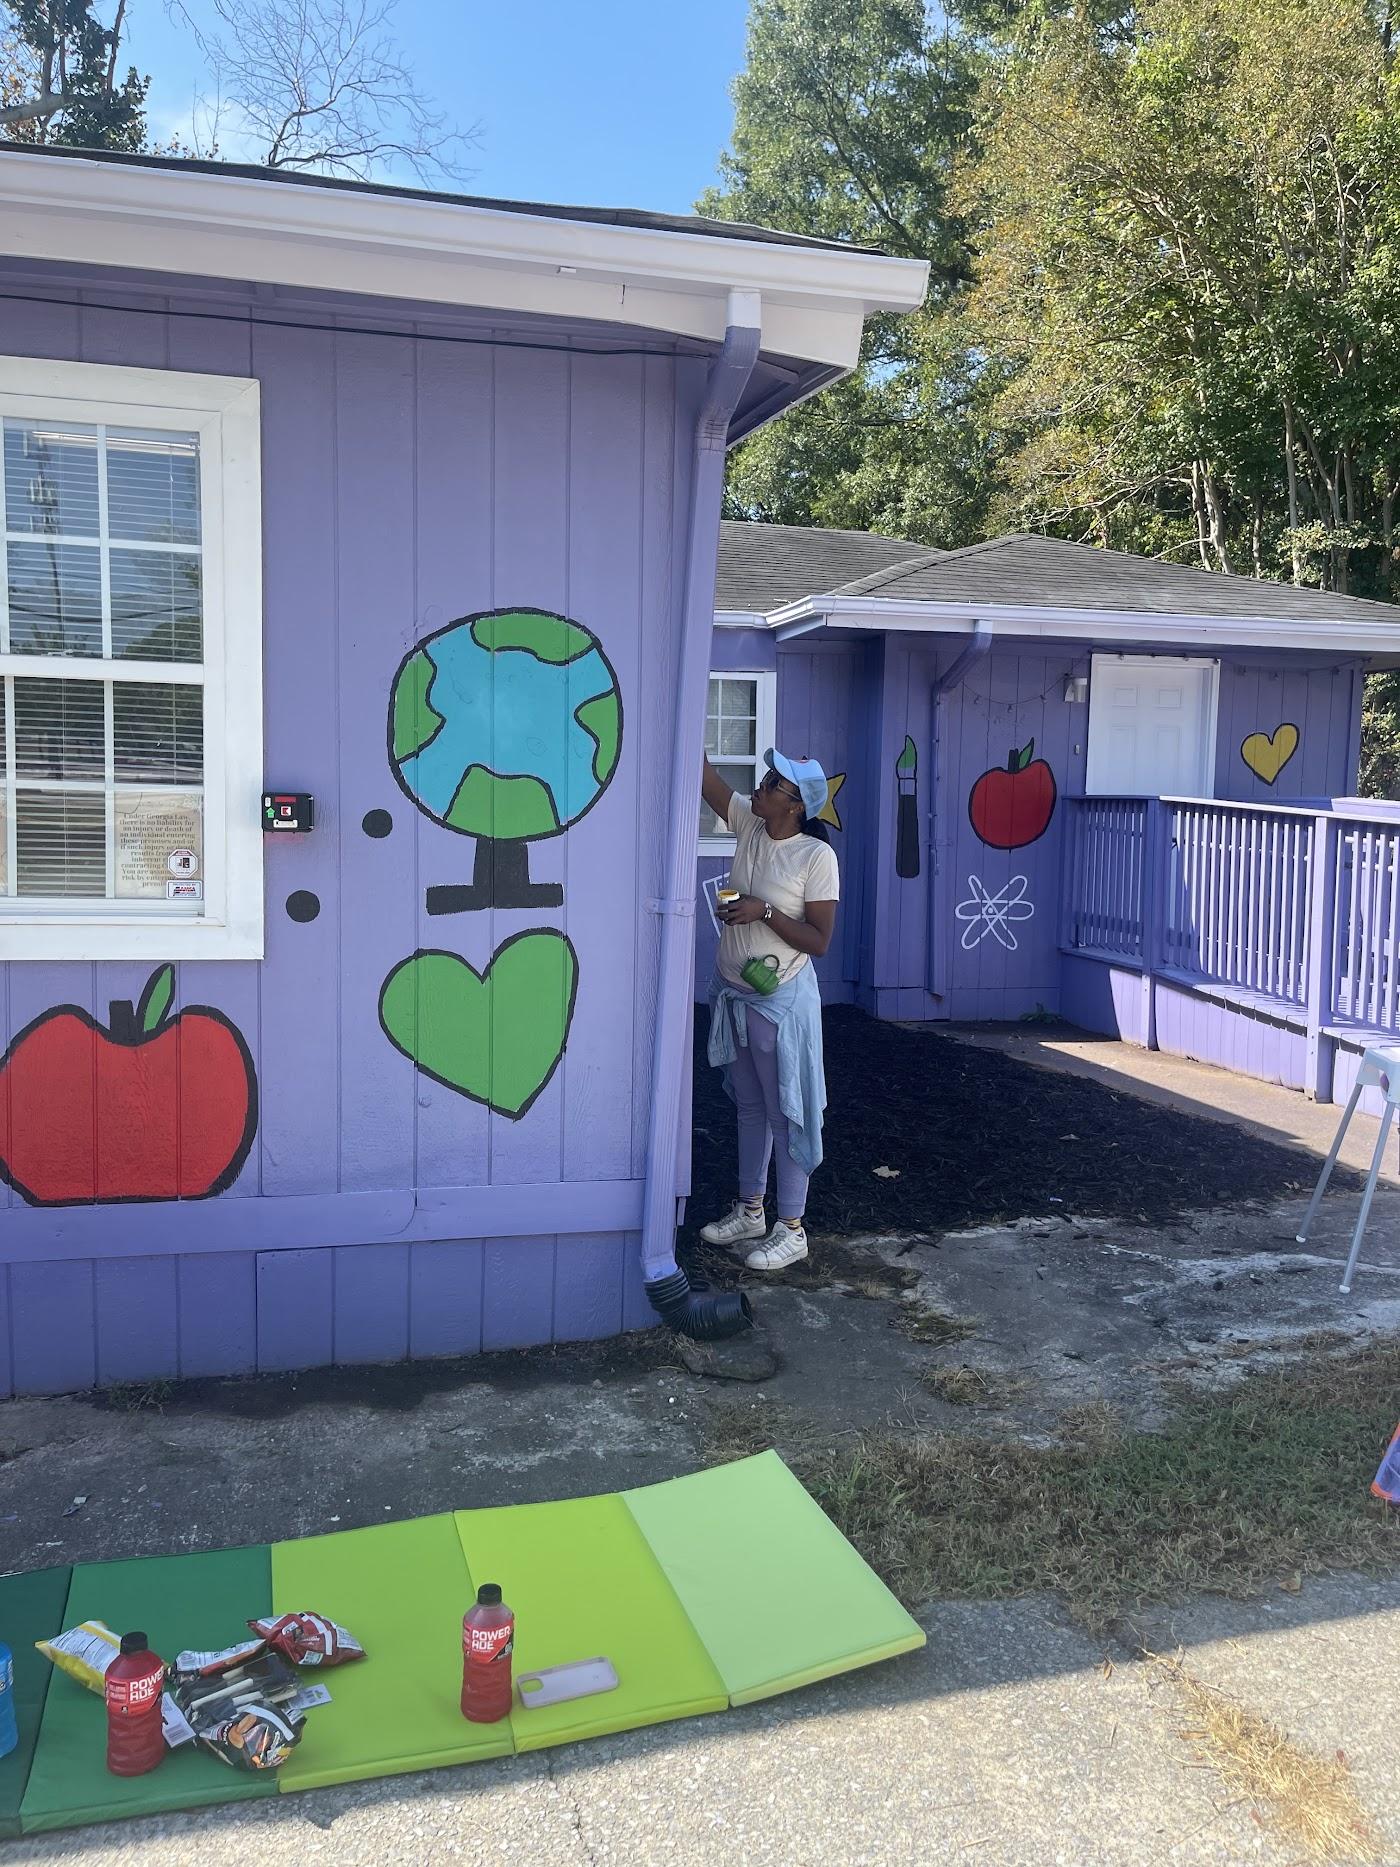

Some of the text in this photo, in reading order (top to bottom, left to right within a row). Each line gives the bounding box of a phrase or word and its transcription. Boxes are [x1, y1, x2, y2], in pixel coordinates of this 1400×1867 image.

[472, 1626, 511, 1641] POWER
[472, 1640, 494, 1650] ADE
[129, 1686, 155, 1702] ADE
